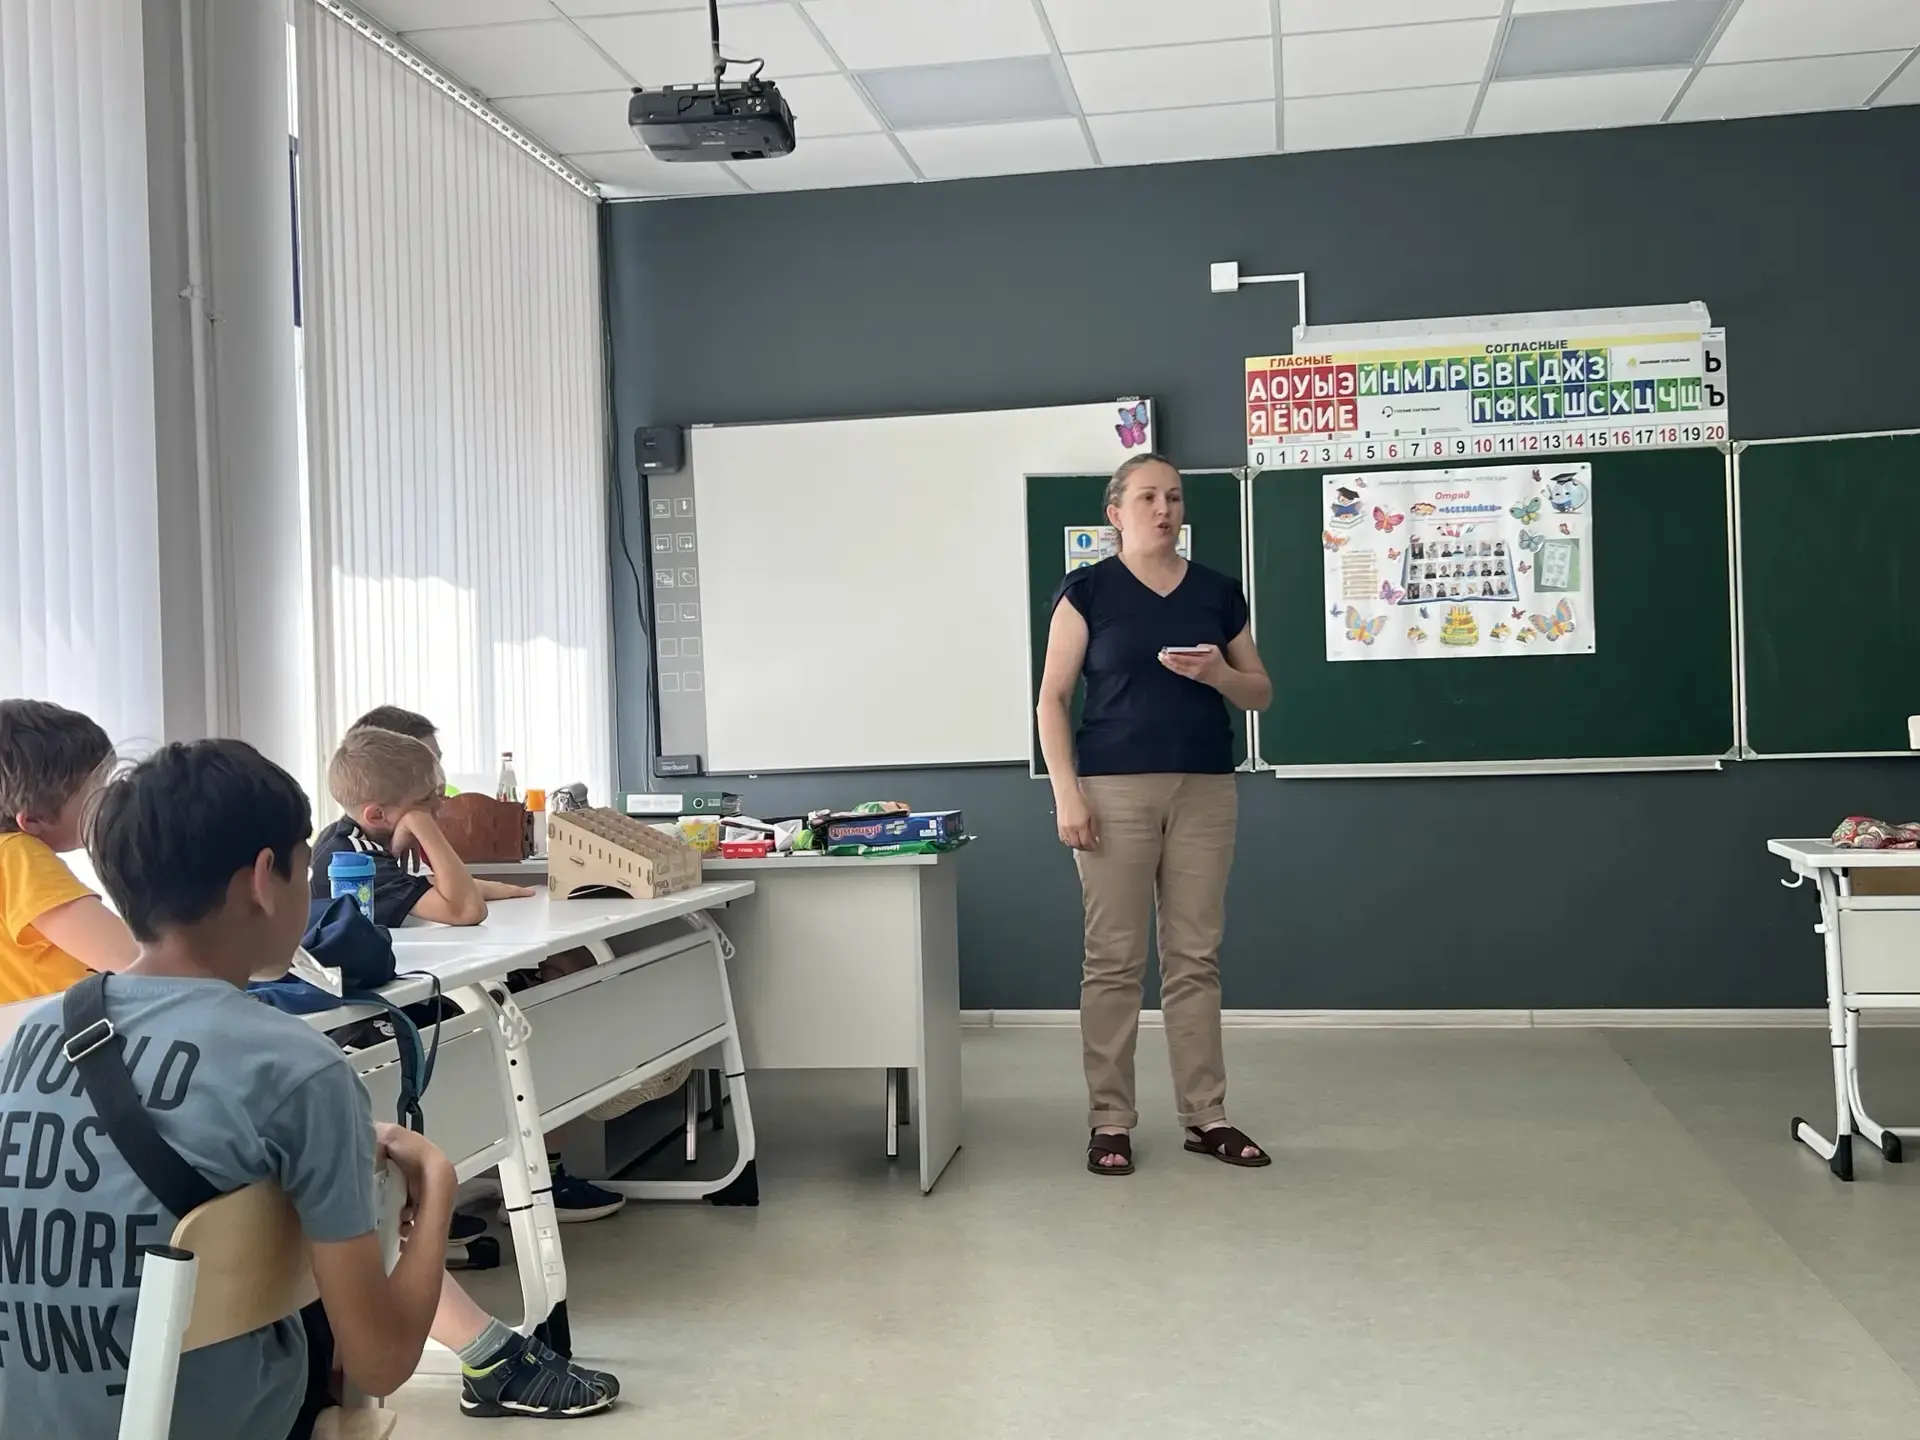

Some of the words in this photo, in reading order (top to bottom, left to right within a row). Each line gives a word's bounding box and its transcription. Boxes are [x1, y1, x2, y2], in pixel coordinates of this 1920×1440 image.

[1269, 354, 1333, 368] ГЛАСНЫЕ
[1485, 339, 1568, 354] СОГЛАСНЫЕ
[1704, 349, 1722, 373] Ь
[1248, 377, 1268, 402] А
[1270, 376, 1289, 400] О
[1292, 374, 1311, 399] У
[1314, 373, 1334, 397] Ы
[1337, 372, 1355, 395] Э
[1359, 365, 1378, 394] Й
[1382, 368, 1400, 393] Н
[1403, 366, 1425, 392] М
[1425, 365, 1448, 390] Л
[1449, 364, 1467, 389] Р
[1472, 362, 1491, 387] Б
[1495, 361, 1514, 386] В
[1519, 359, 1535, 384] Г
[1539, 355, 1563, 386] Д
[1562, 357, 1586, 382] Ж
[1588, 355, 1606, 380] З
[1473, 396, 1492, 421] П
[1495, 395, 1518, 422] Ф
[1520, 394, 1538, 419] К
[1542, 393, 1560, 417] Т
[1563, 392, 1587, 417] Ш
[1588, 390, 1606, 414] С
[1611, 390, 1633, 413] Х
[1634, 387, 1656, 415] Ц
[1658, 386, 1677, 410] Ч
[1680, 383, 1704, 412] Щ
[1703, 383, 1725, 407] Ъ
[1250, 410, 1267, 434] Я
[1273, 403, 1289, 433] Ё
[1292, 407, 1314, 432] Ю
[1316, 406, 1335, 430] И
[1338, 404, 1355, 429] Е
[1256, 452, 1265, 466] 0
[1279, 450, 1286, 465] 1
[1300, 449, 1309, 463] 2
[1322, 448, 1331, 462] 3
[1343, 447, 1353, 461] 4
[1366, 445, 1375, 459] 5
[1388, 444, 1398, 458] 6
[1410, 442, 1420, 457] 7
[1433, 441, 1443, 456] 8
[1456, 440, 1465, 454] 9
[1474, 438, 1492, 453] 10
[1498, 437, 1514, 452] 11
[1520, 436, 1538, 451] 12
[1543, 434, 1561, 449] 13
[1566, 433, 1584, 448] 14
[1589, 432, 1608, 447] 15
[1612, 430, 1631, 445] 16
[1635, 429, 1654, 444] 17
[1658, 427, 1678, 443] 18
[1682, 426, 1701, 442] 19
[1705, 425, 1725, 440] 20
[1434, 490, 1471, 501] Отряд
[0, 1111, 107, 1193] EDS
[0, 1206, 158, 1288] MORE
